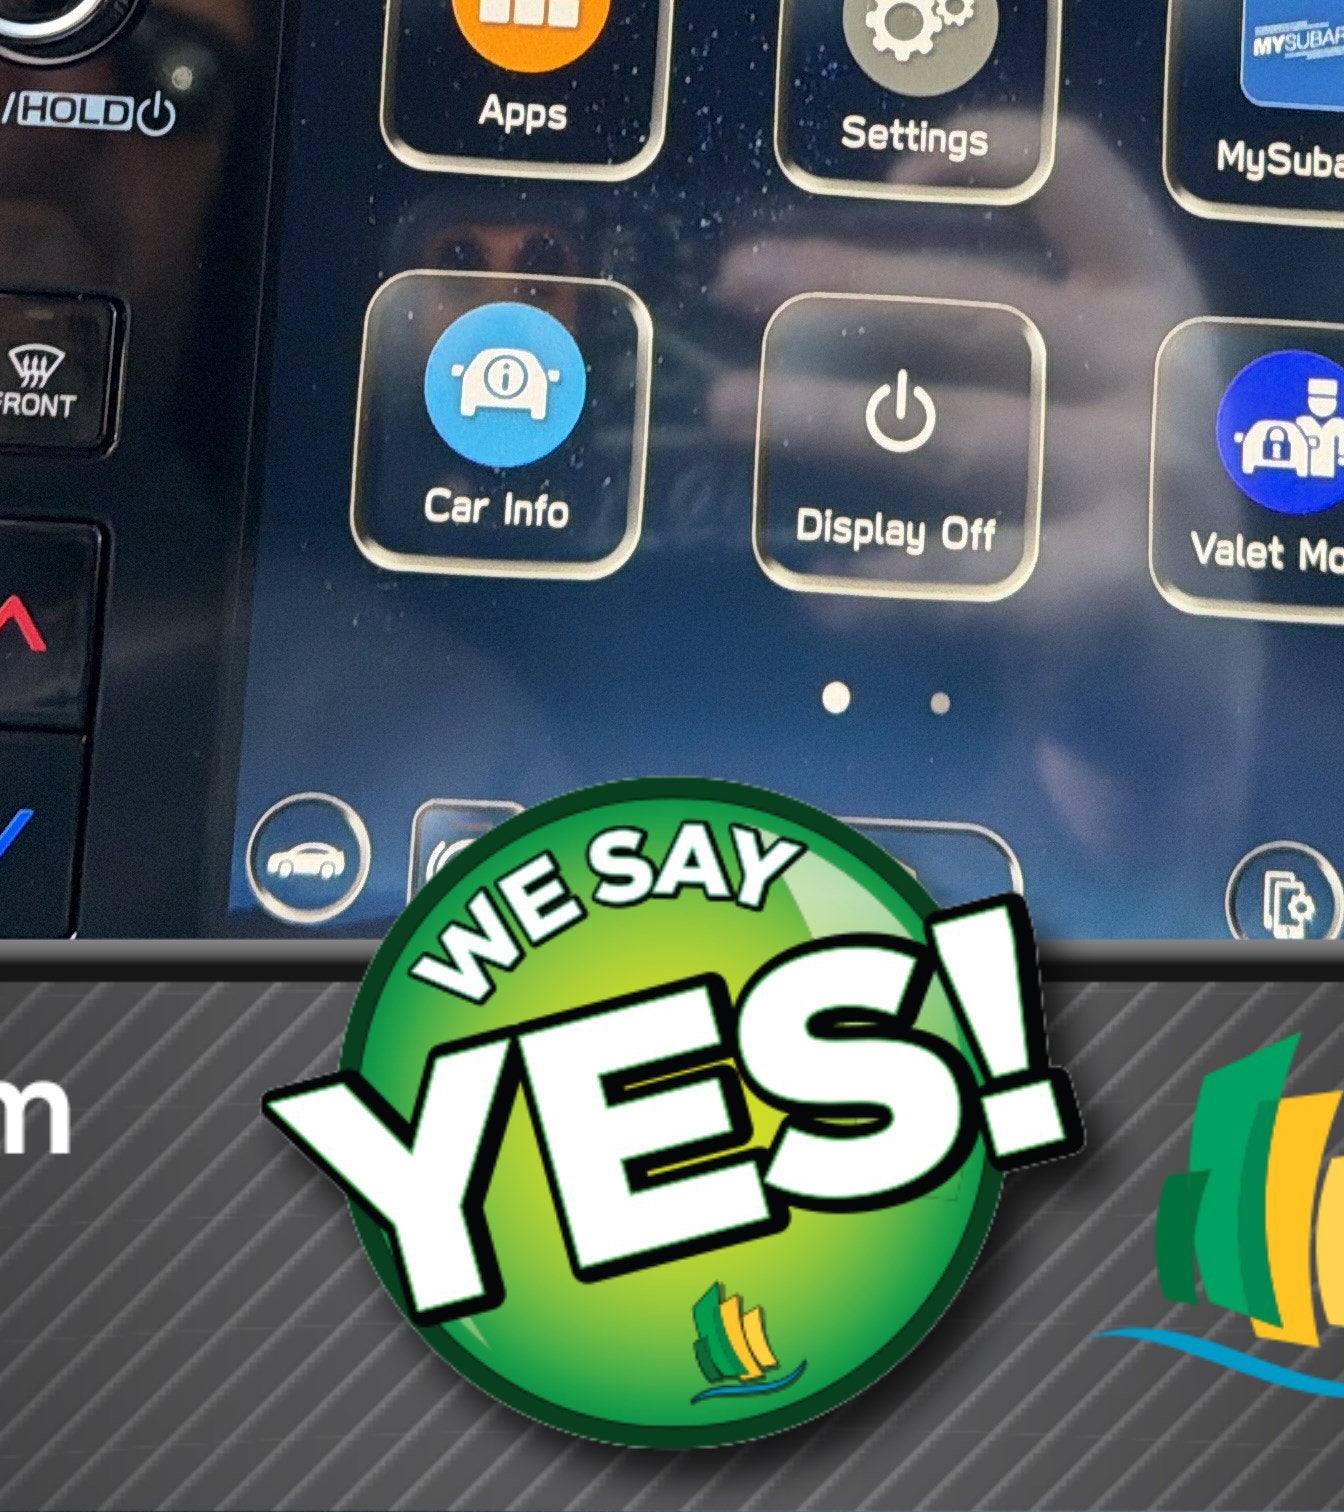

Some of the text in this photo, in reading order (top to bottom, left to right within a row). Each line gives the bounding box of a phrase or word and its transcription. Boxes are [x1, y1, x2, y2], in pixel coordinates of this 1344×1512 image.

[22, 96, 130, 128] HOLD
[478, 93, 568, 136] Apps
[841, 115, 989, 163] Settings
[424, 487, 569, 529] Car Info
[796, 507, 997, 557] Display Off
[1190, 530, 1285, 571] Valet
